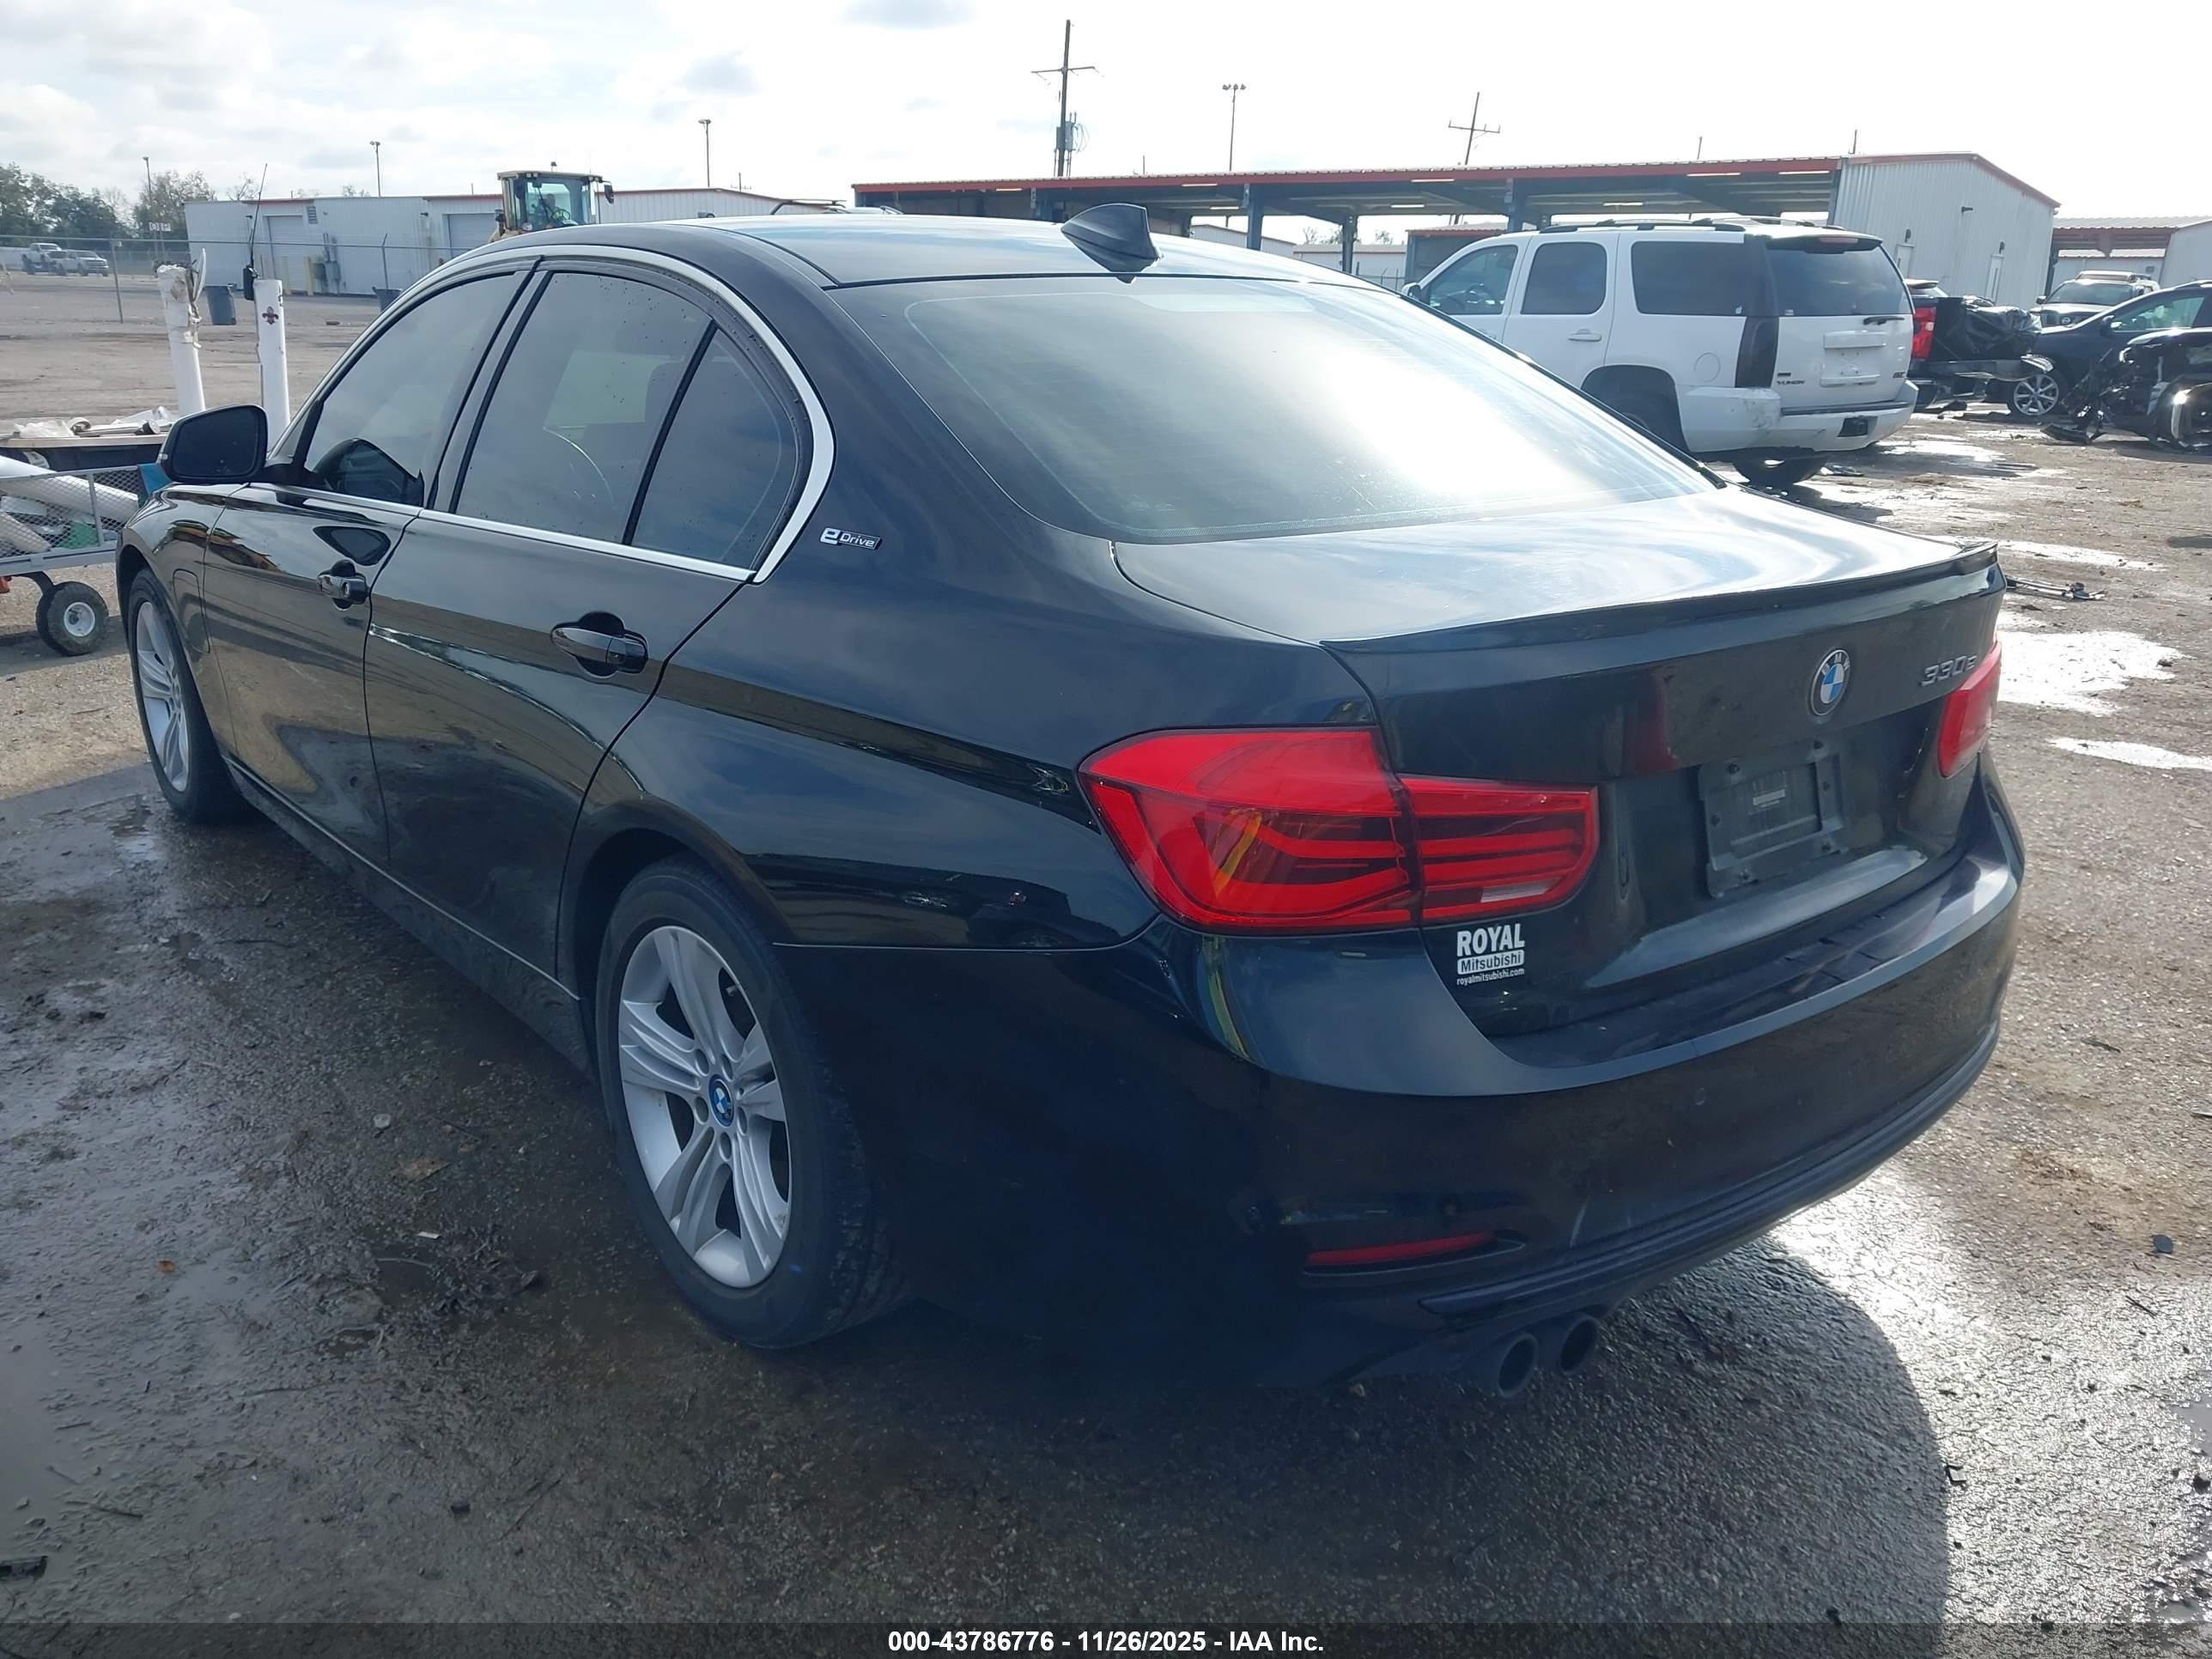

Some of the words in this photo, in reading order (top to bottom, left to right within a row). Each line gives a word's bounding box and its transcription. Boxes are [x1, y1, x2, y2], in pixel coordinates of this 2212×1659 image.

[1456, 923, 1525, 957] ROYAL
[1461, 951, 1522, 973] Mitsubishi
[1456, 968, 1524, 986] royalmitsubishi.com
